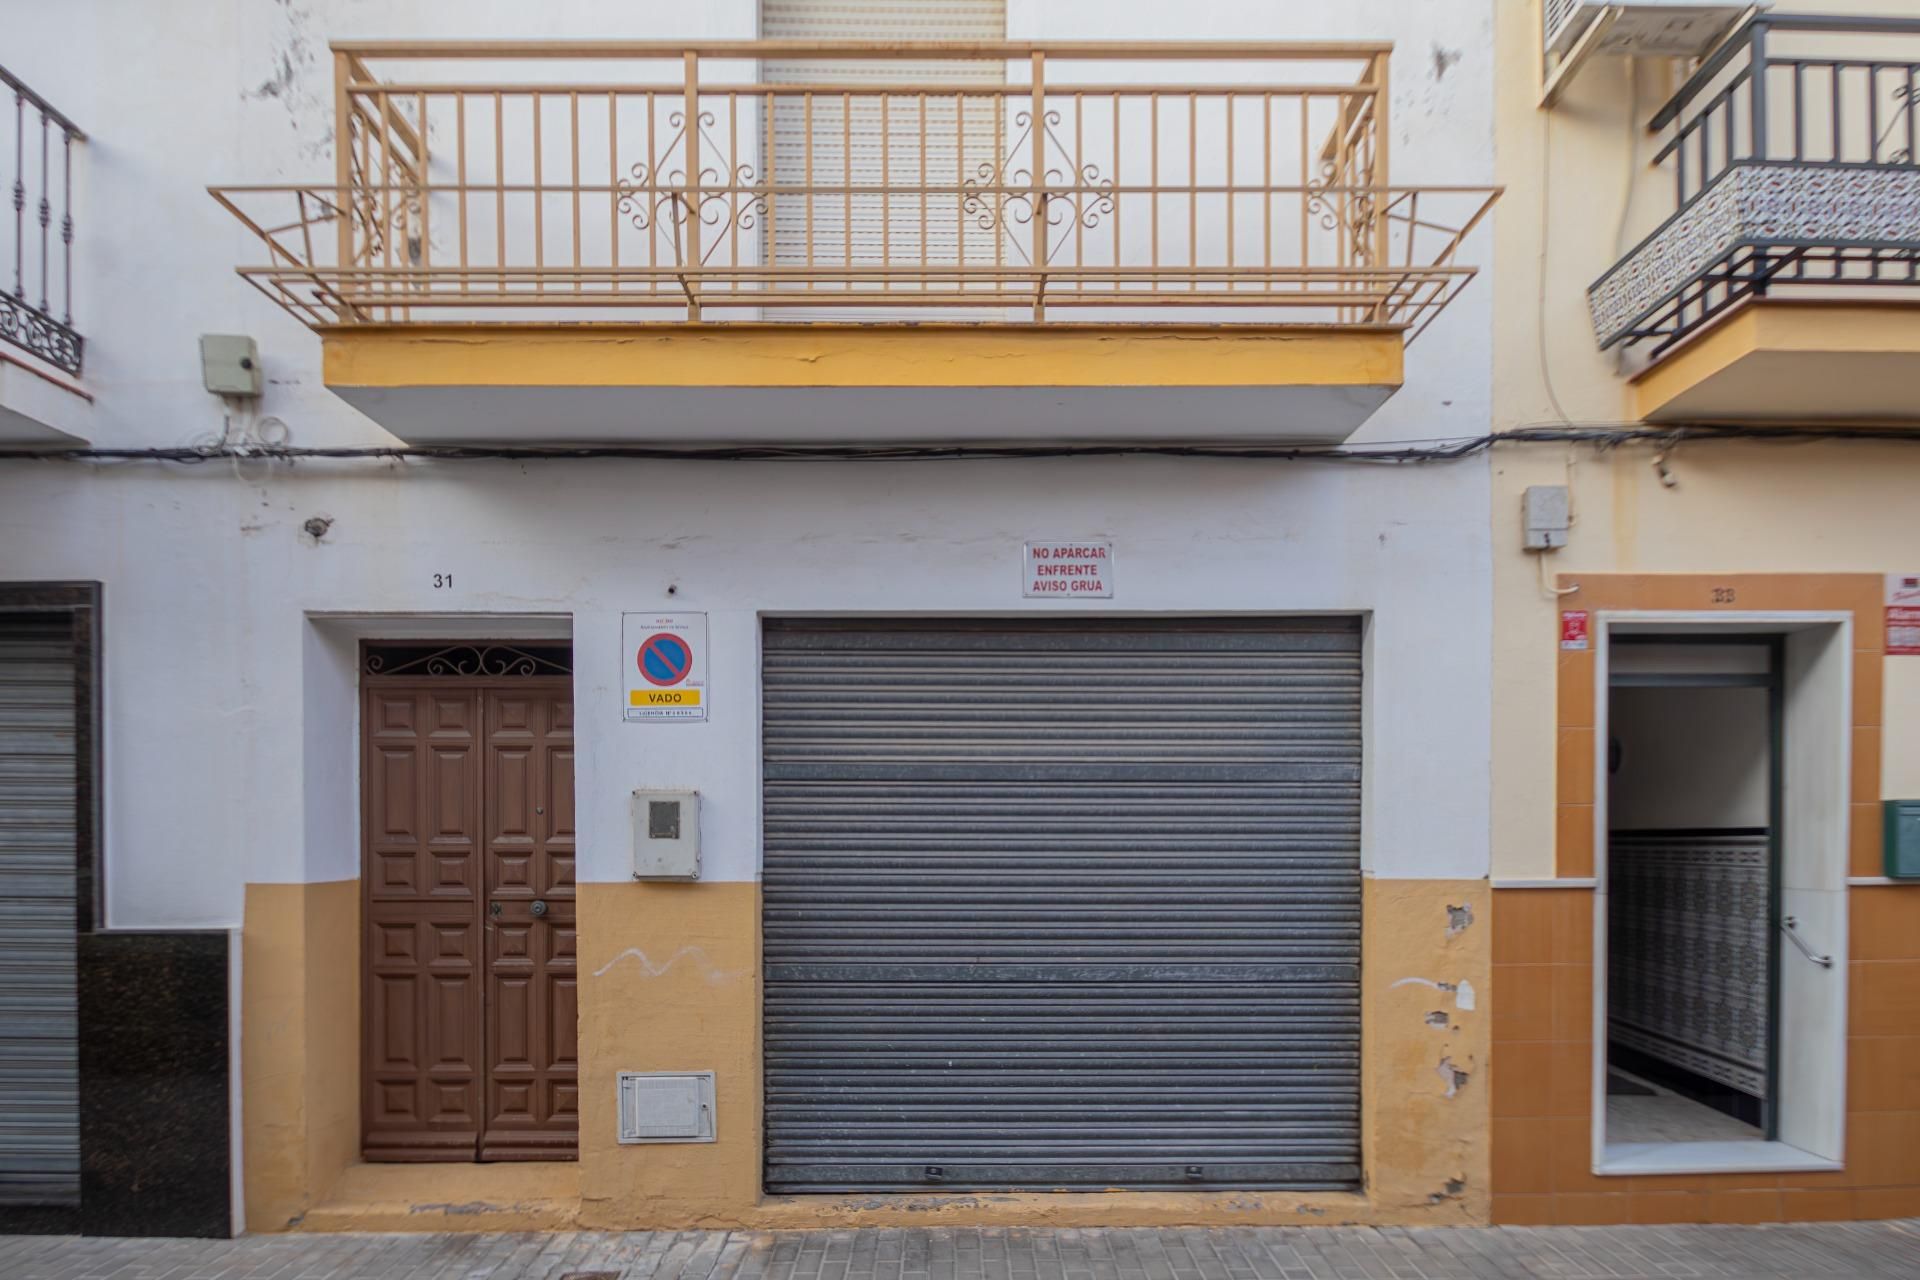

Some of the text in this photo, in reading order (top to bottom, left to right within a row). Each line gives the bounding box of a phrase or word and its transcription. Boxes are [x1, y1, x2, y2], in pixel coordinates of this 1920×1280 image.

[1032, 547, 1106, 559] NO APARCAR
[1037, 564, 1097, 576] ENFRENTE
[433, 573, 452, 588] 31
[1033, 580, 1103, 591] AVISO GRUA
[648, 693, 682, 703] VADO
